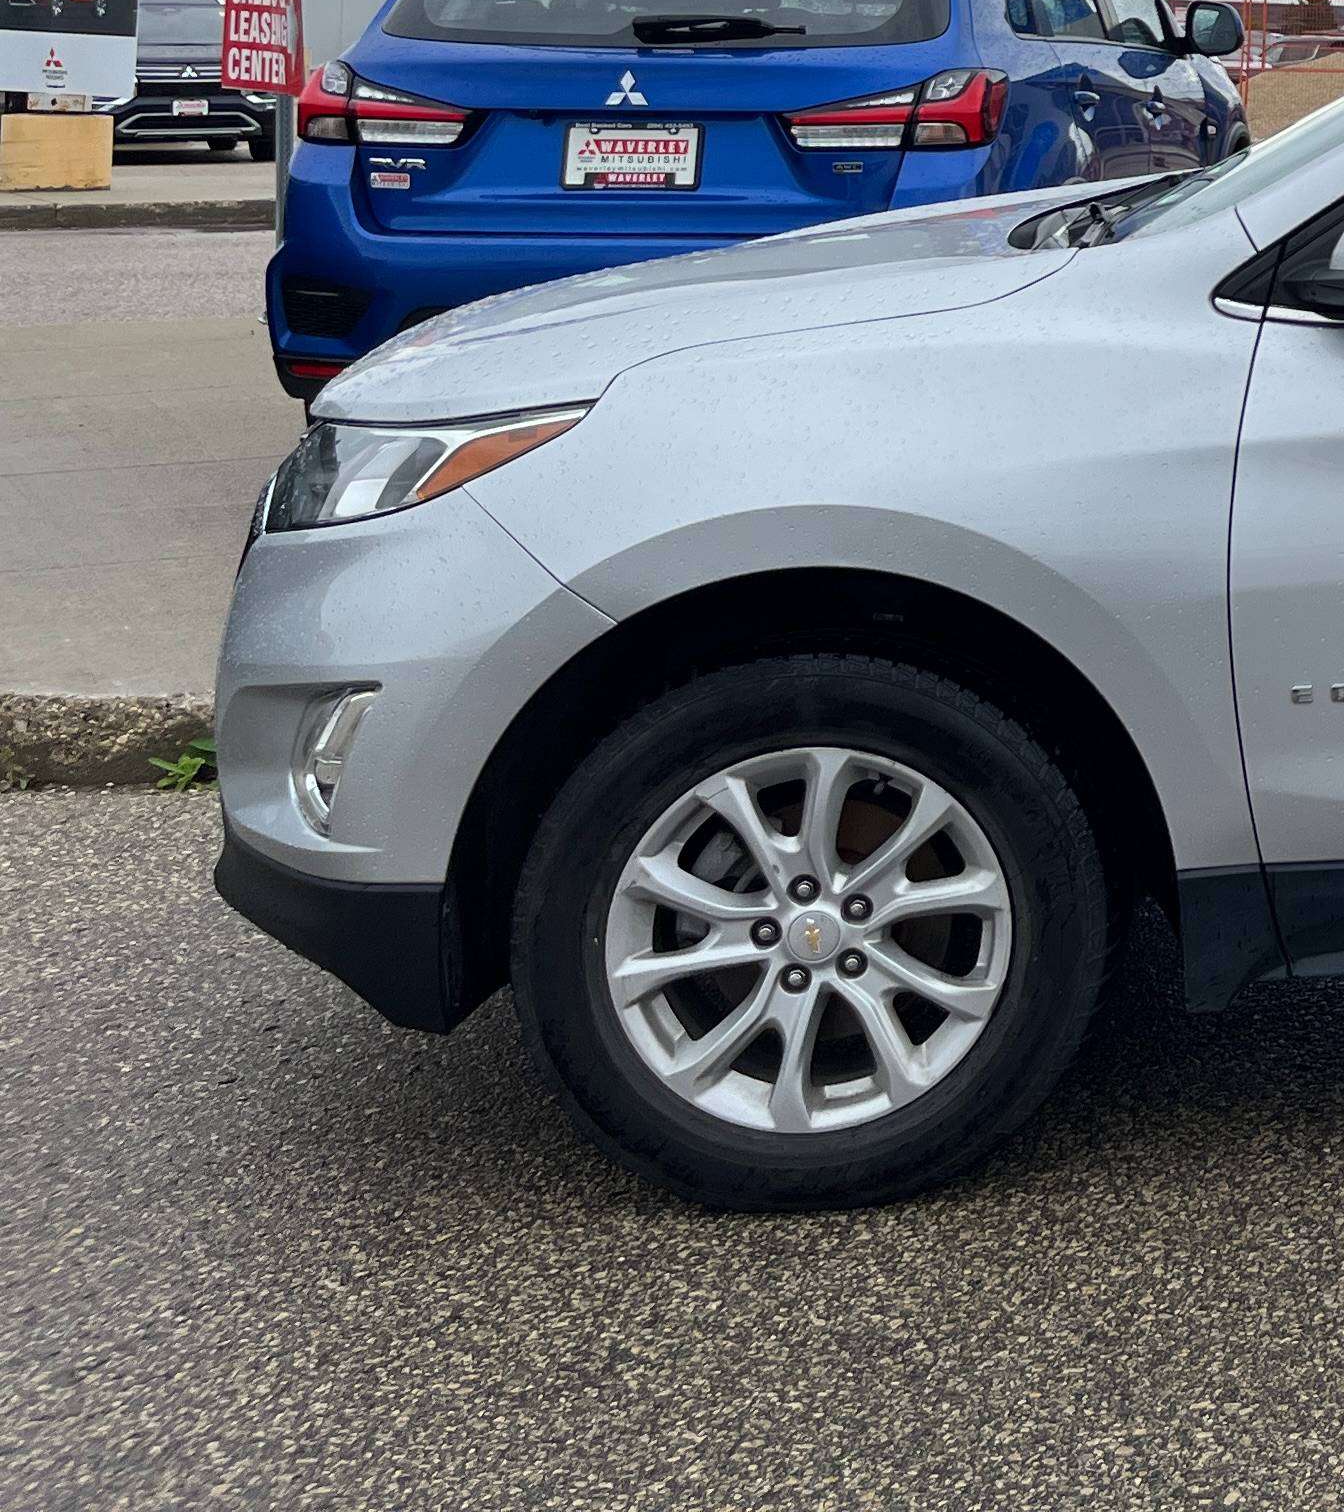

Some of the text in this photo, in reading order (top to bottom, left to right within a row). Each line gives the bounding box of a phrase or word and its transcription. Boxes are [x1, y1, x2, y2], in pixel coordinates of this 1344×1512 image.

[229, 9, 288, 48] LEASING
[227, 46, 287, 86] CENTER
[600, 140, 688, 154] WAVERLEY
[600, 155, 688, 164] MITSUBISHI
[608, 173, 666, 182] WAVERLEY
